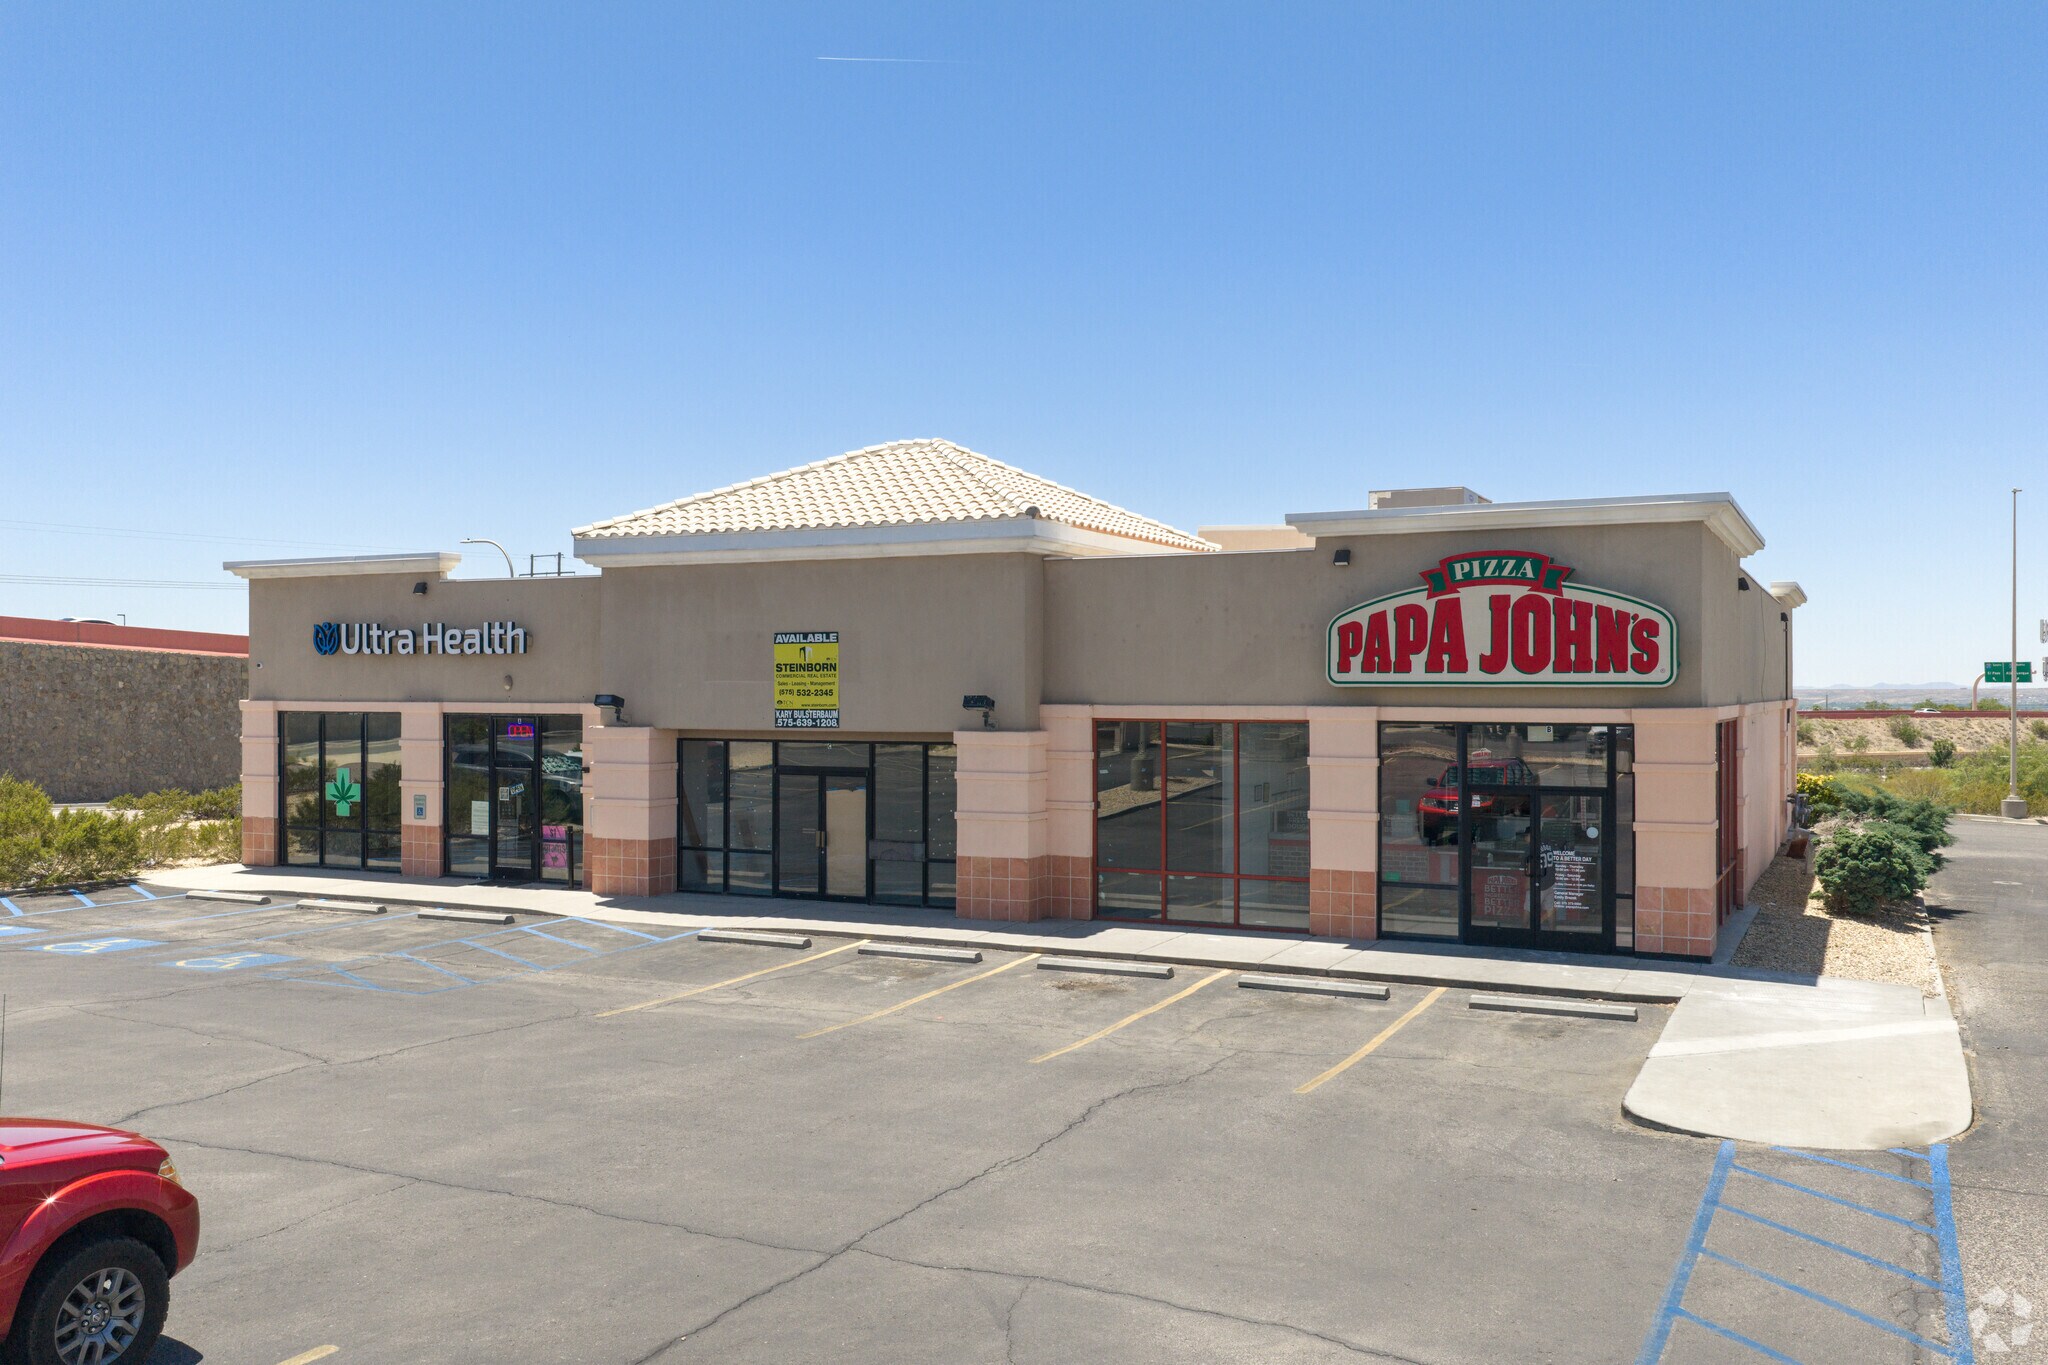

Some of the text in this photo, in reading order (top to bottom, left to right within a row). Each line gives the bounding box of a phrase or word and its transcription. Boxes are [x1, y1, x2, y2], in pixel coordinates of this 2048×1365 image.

[1452, 557, 1535, 581] PIZZA
[341, 621, 527, 655] Ultra Health
[775, 633, 837, 643] AVAILABLE
[1336, 594, 1660, 675] PAPA JOHN'S
[776, 663, 836, 672] STEINBORN
[796, 689, 834, 697] 532-2345
[776, 710, 793, 718] KARY
[777, 719, 837, 727] 575-639-1208
[509, 725, 533, 737] OPEN
